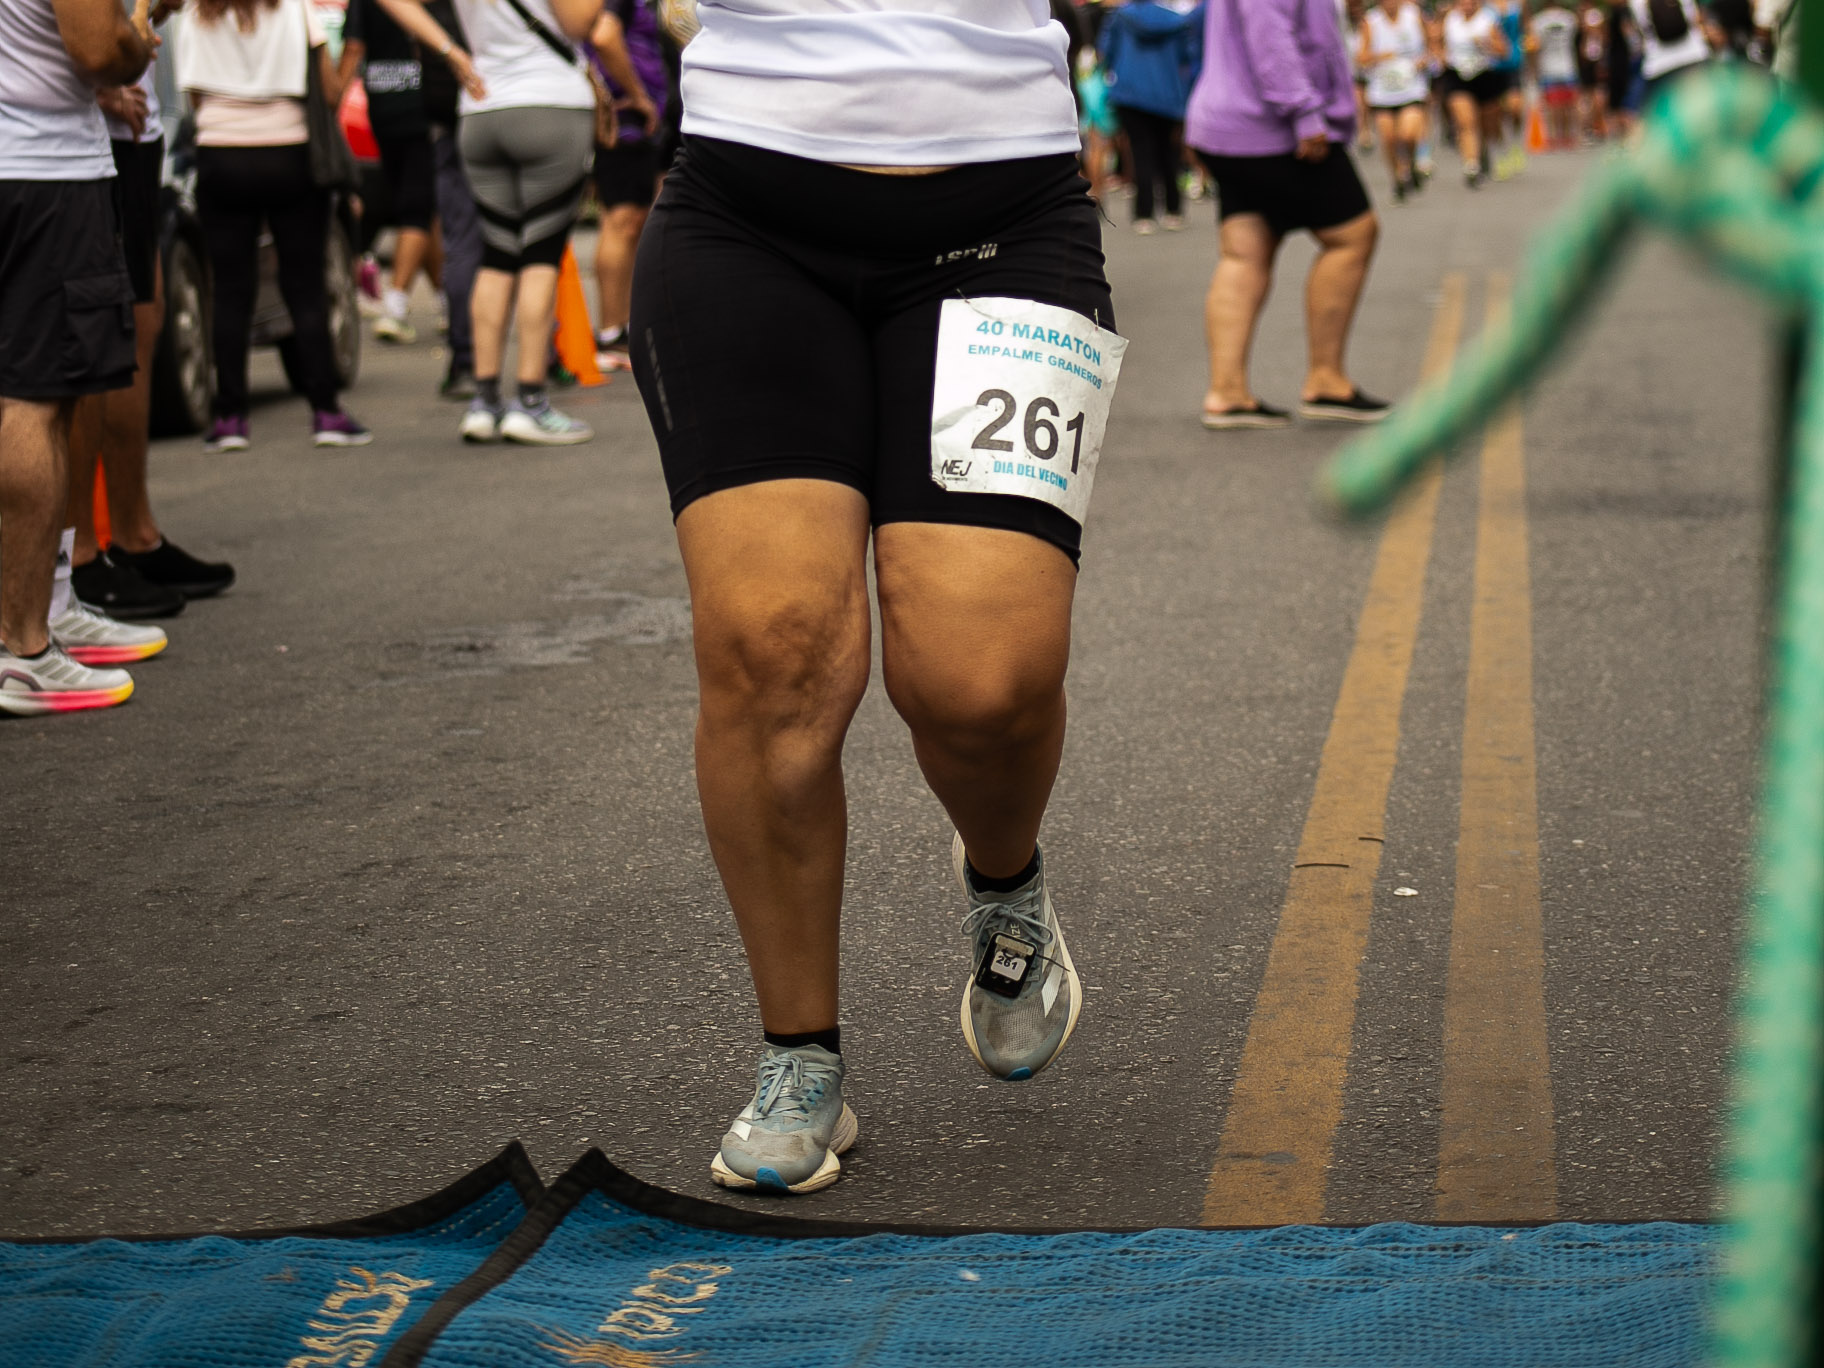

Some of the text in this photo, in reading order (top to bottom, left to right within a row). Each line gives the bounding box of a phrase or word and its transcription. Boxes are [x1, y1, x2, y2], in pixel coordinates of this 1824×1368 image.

[976, 320, 1101, 367] 40 MARATON
[968, 344, 1103, 390] EMPALME GRANEROS
[971, 388, 1085, 475] 261
[940, 459, 972, 477] NEJ
[993, 460, 1068, 491] DIA DEL VECINO
[996, 955, 1018, 971] 261
